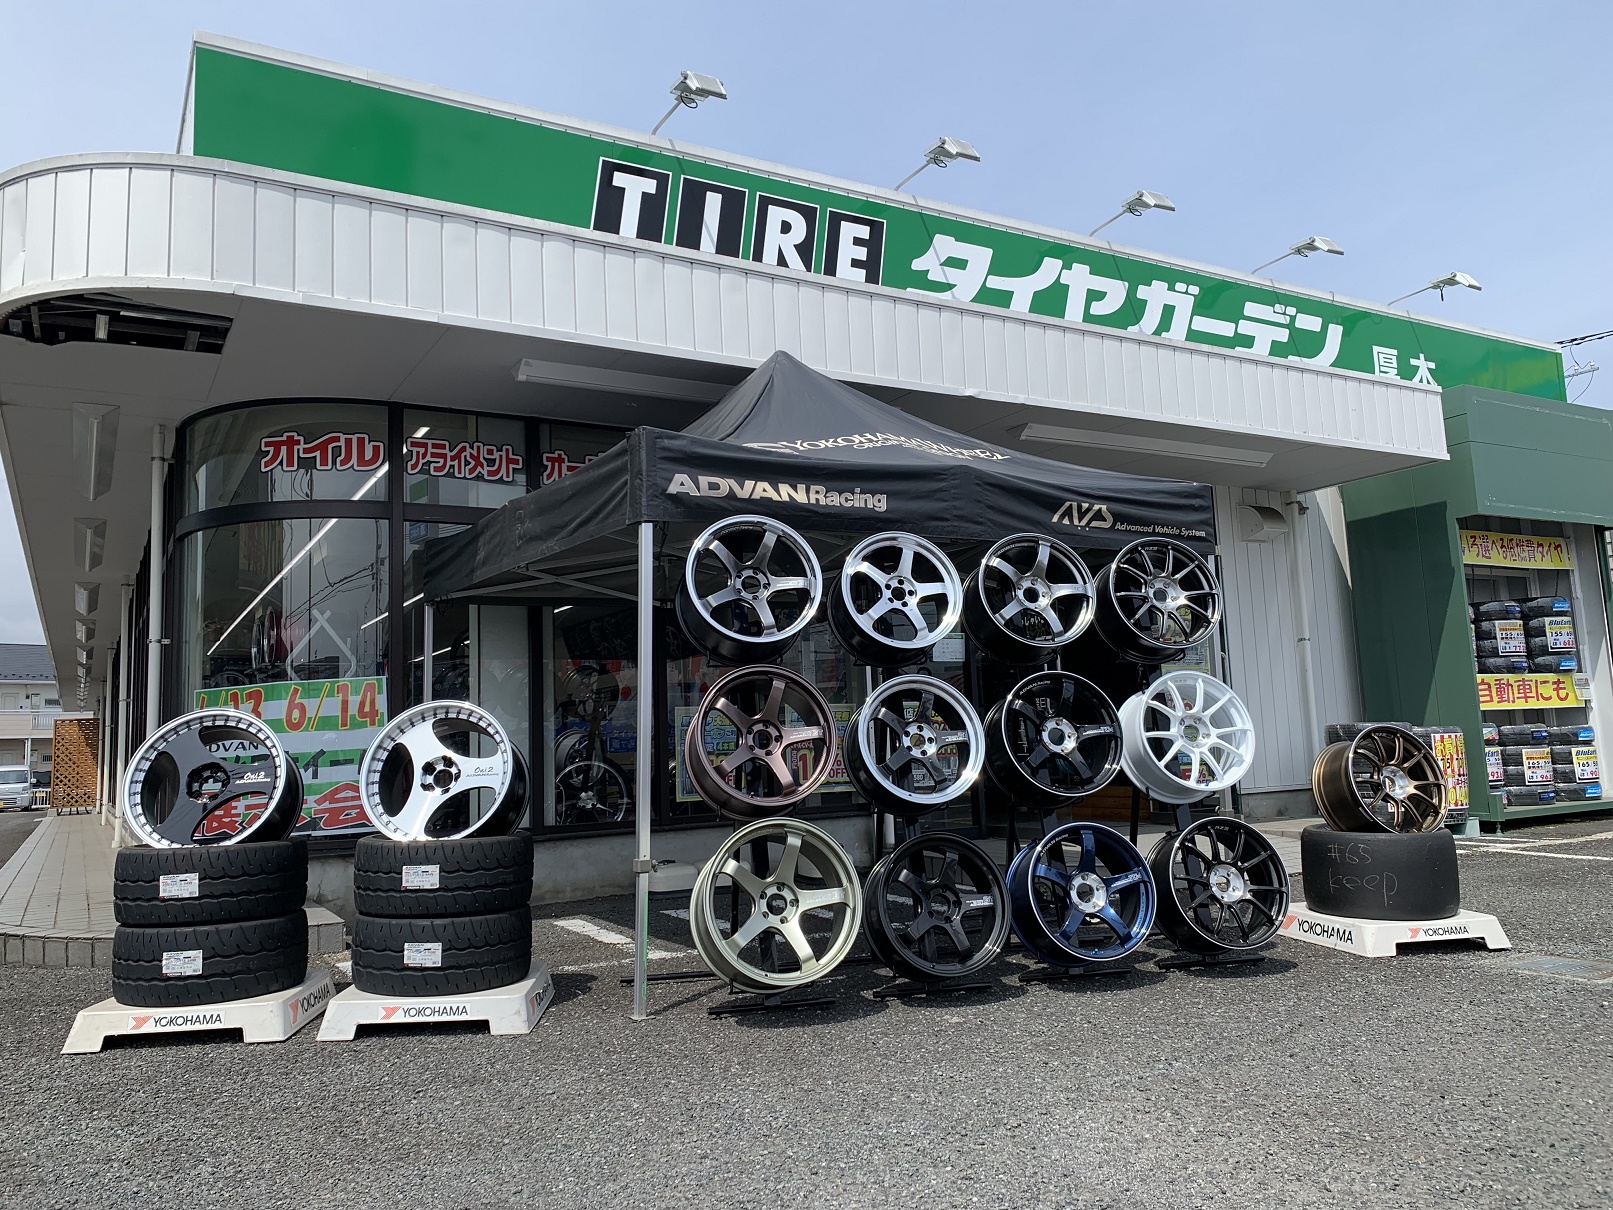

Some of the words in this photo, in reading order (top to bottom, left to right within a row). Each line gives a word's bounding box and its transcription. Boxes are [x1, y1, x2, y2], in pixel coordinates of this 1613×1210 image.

[612, 171, 871, 283] TIRE
[905, 233, 1343, 367] タイヤガーデン
[1372, 345, 1438, 386] 厚木
[260, 431, 385, 473] オイル
[406, 436, 523, 482] アライメント
[666, 473, 809, 504] ADVAN
[809, 485, 888, 513] Racing
[1115, 521, 1153, 533] Advanced
[1154, 524, 1180, 535] Vehicle
[1180, 527, 1206, 538] System
[285, 681, 379, 732] 6/14
[208, 741, 259, 753] DVAN
[1327, 867, 1398, 909] keep
[1297, 918, 1354, 945] YOKOHAMA
[1421, 925, 1470, 938] YOKOHAMA
[299, 982, 331, 1015] YOKOHAMA
[402, 1005, 469, 1018] YOKOHAMA
[153, 1013, 223, 1028] YOKOHAMA
